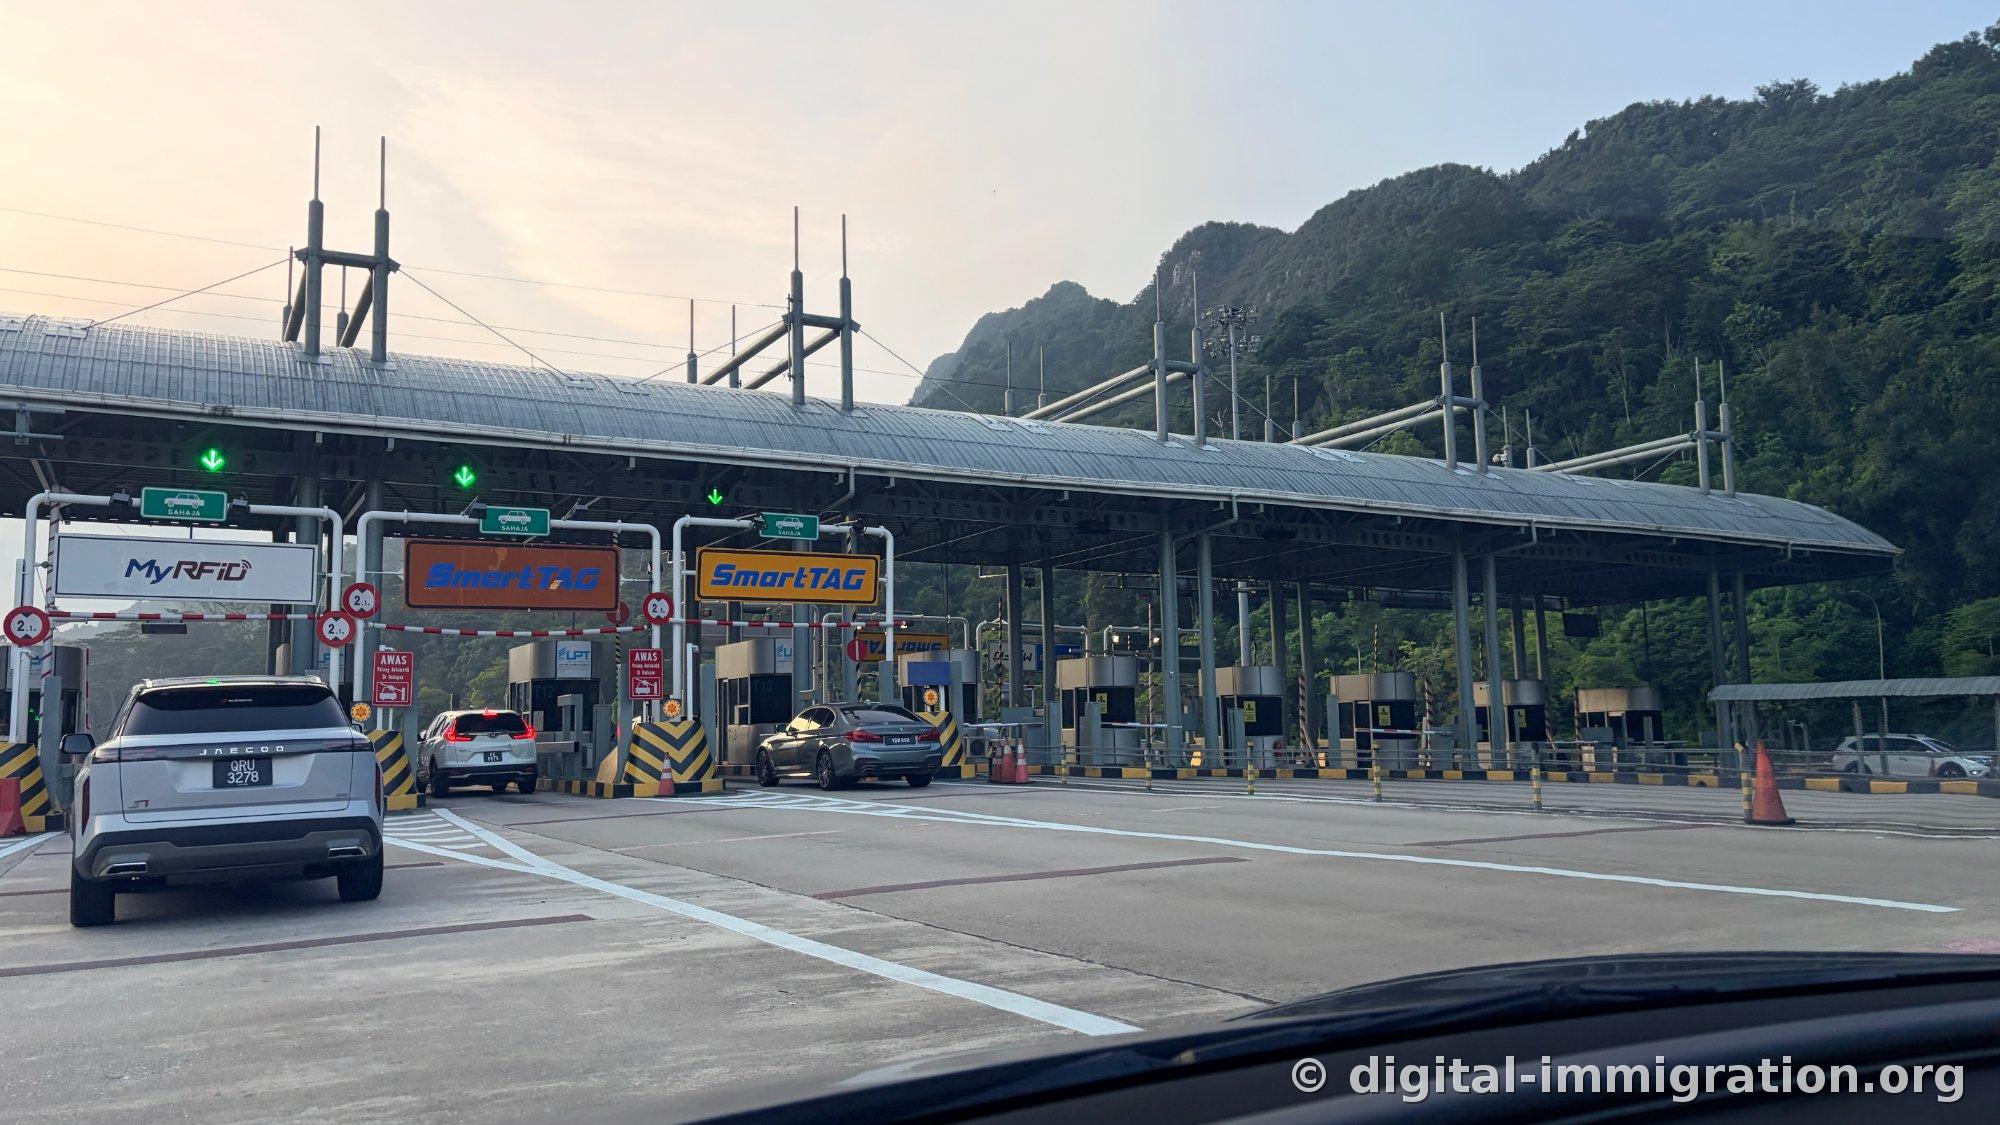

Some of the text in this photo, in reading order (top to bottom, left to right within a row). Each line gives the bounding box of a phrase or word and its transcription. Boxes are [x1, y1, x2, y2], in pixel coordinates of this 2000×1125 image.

[167, 508, 201, 517] SAHAJA
[501, 524, 529, 532] SAHAJA
[777, 530, 801, 538] SAHAJA
[124, 558, 252, 585] MyRFID
[426, 562, 602, 590] SmartTAG
[710, 563, 866, 590] SmartTAG
[381, 655, 407, 665] AWAS
[634, 652, 658, 662] AWAS
[199, 745, 284, 756] JAECOO
[231, 759, 256, 771] QRU
[227, 771, 259, 784] 3278
